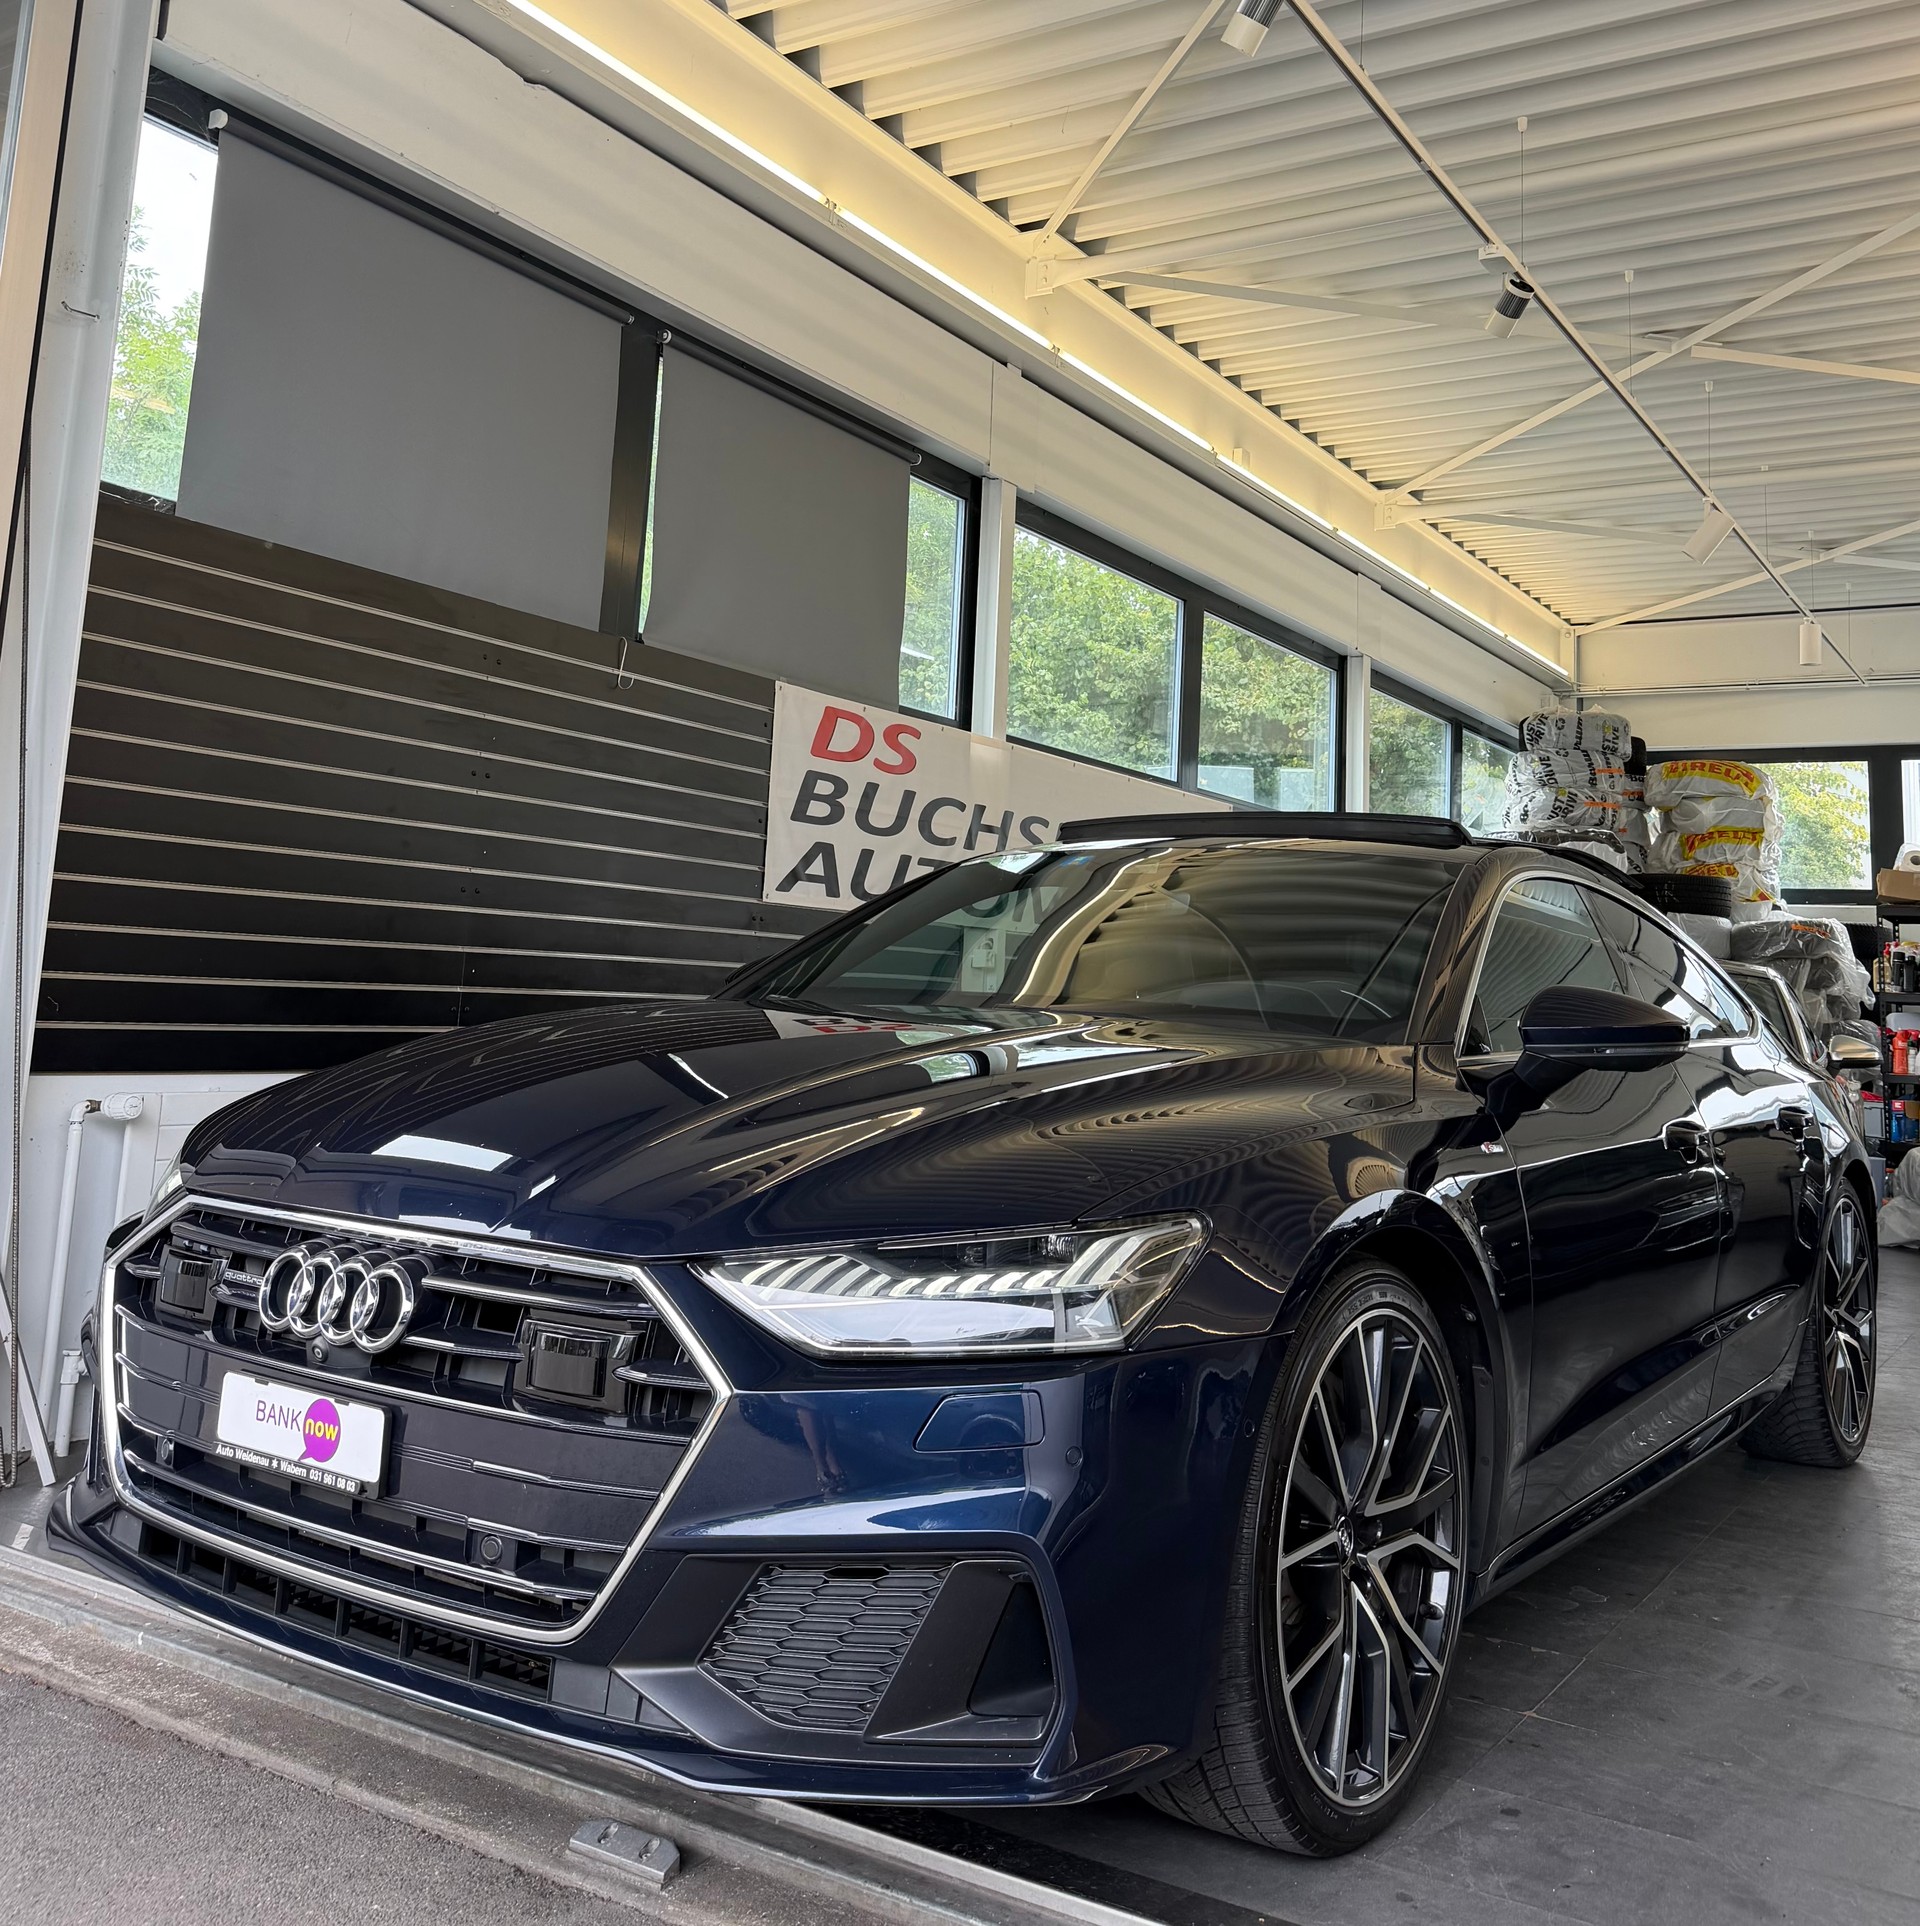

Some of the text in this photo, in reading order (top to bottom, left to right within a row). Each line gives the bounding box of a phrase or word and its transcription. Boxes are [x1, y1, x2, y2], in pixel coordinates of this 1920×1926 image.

[810, 705, 922, 776] DS
[225, 1271, 263, 1285] quattro
[256, 1399, 339, 1442] BANK now
[216, 1444, 235, 1458] Auto
[280, 1460, 307, 1477] Wabern
[309, 1468, 323, 1482] 031
